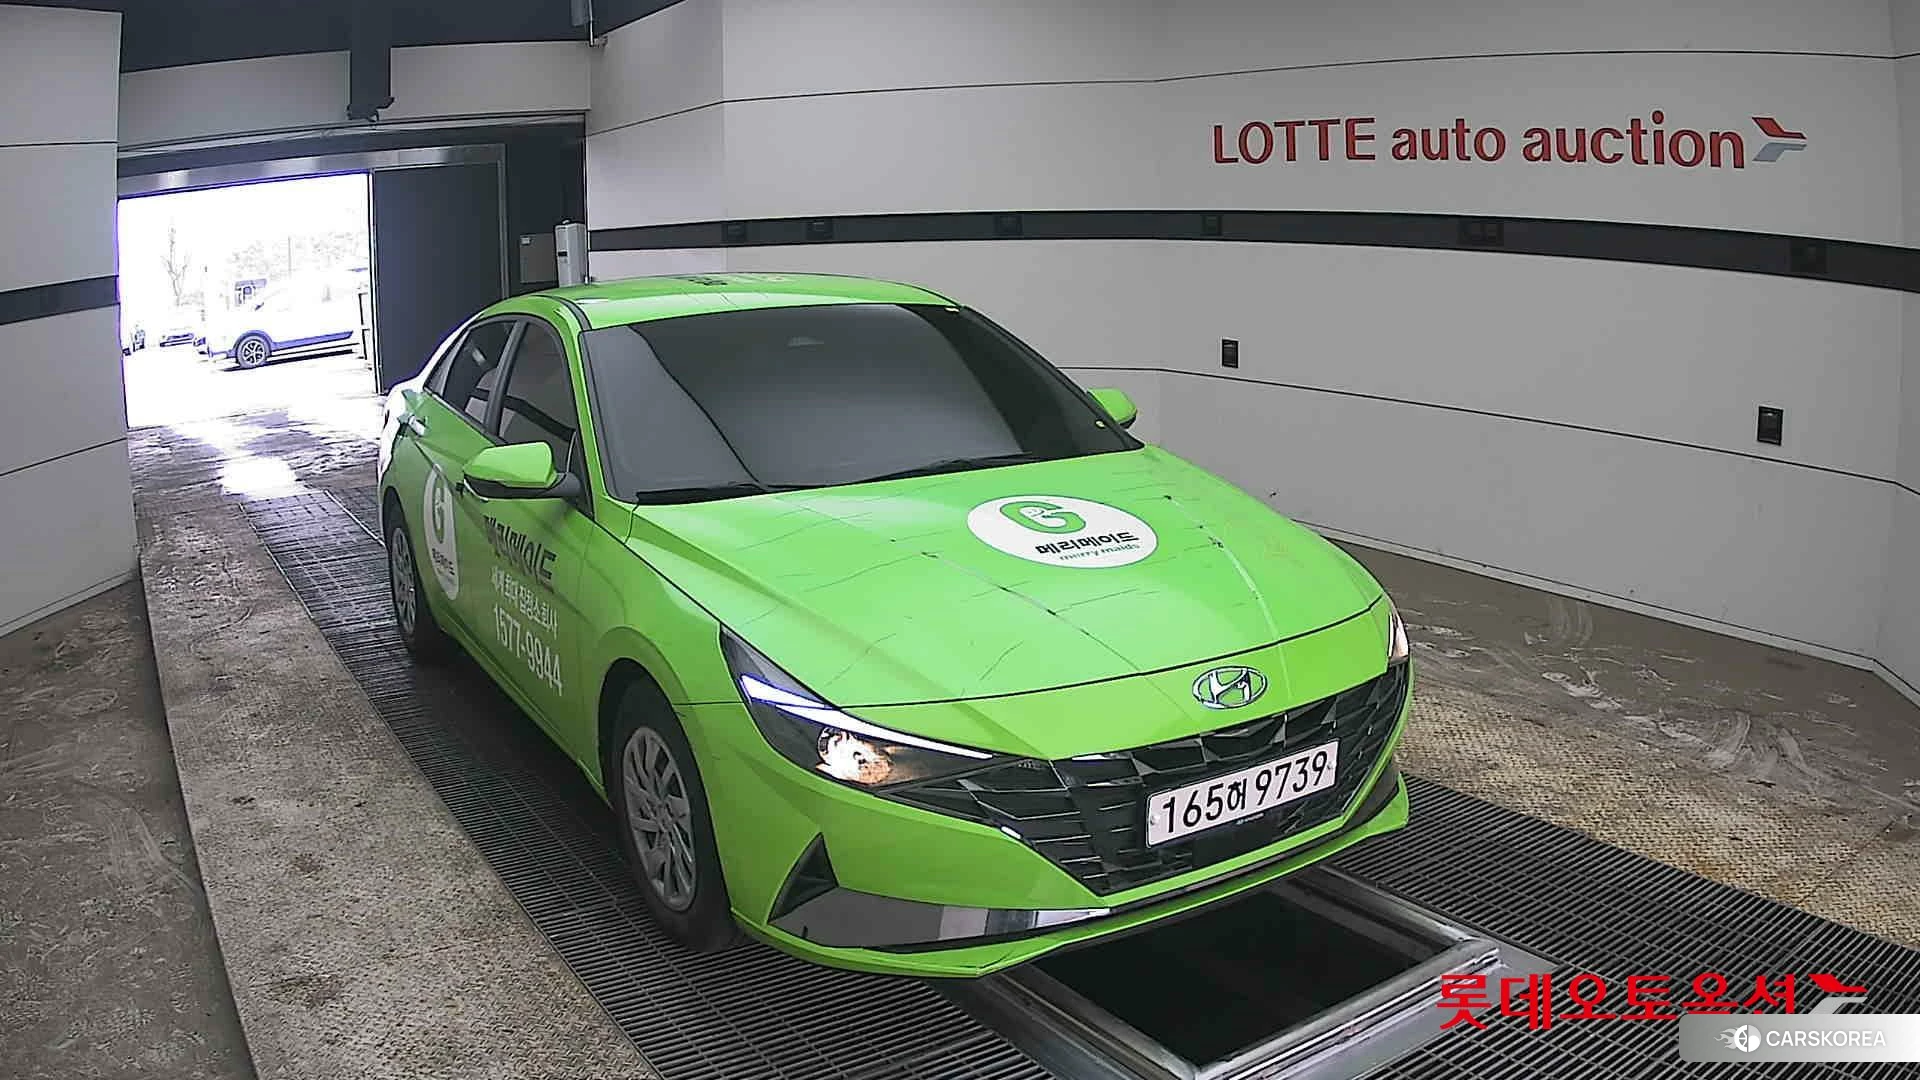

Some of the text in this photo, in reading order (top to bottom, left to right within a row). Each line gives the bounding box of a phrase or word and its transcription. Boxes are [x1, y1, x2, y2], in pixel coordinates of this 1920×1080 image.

[1213, 110, 1745, 169] LOTTE auto auction
[1035, 532, 1139, 554] 메리메이드
[494, 603, 562, 697] 1577-9944
[1162, 751, 1328, 833] 165허 9739
